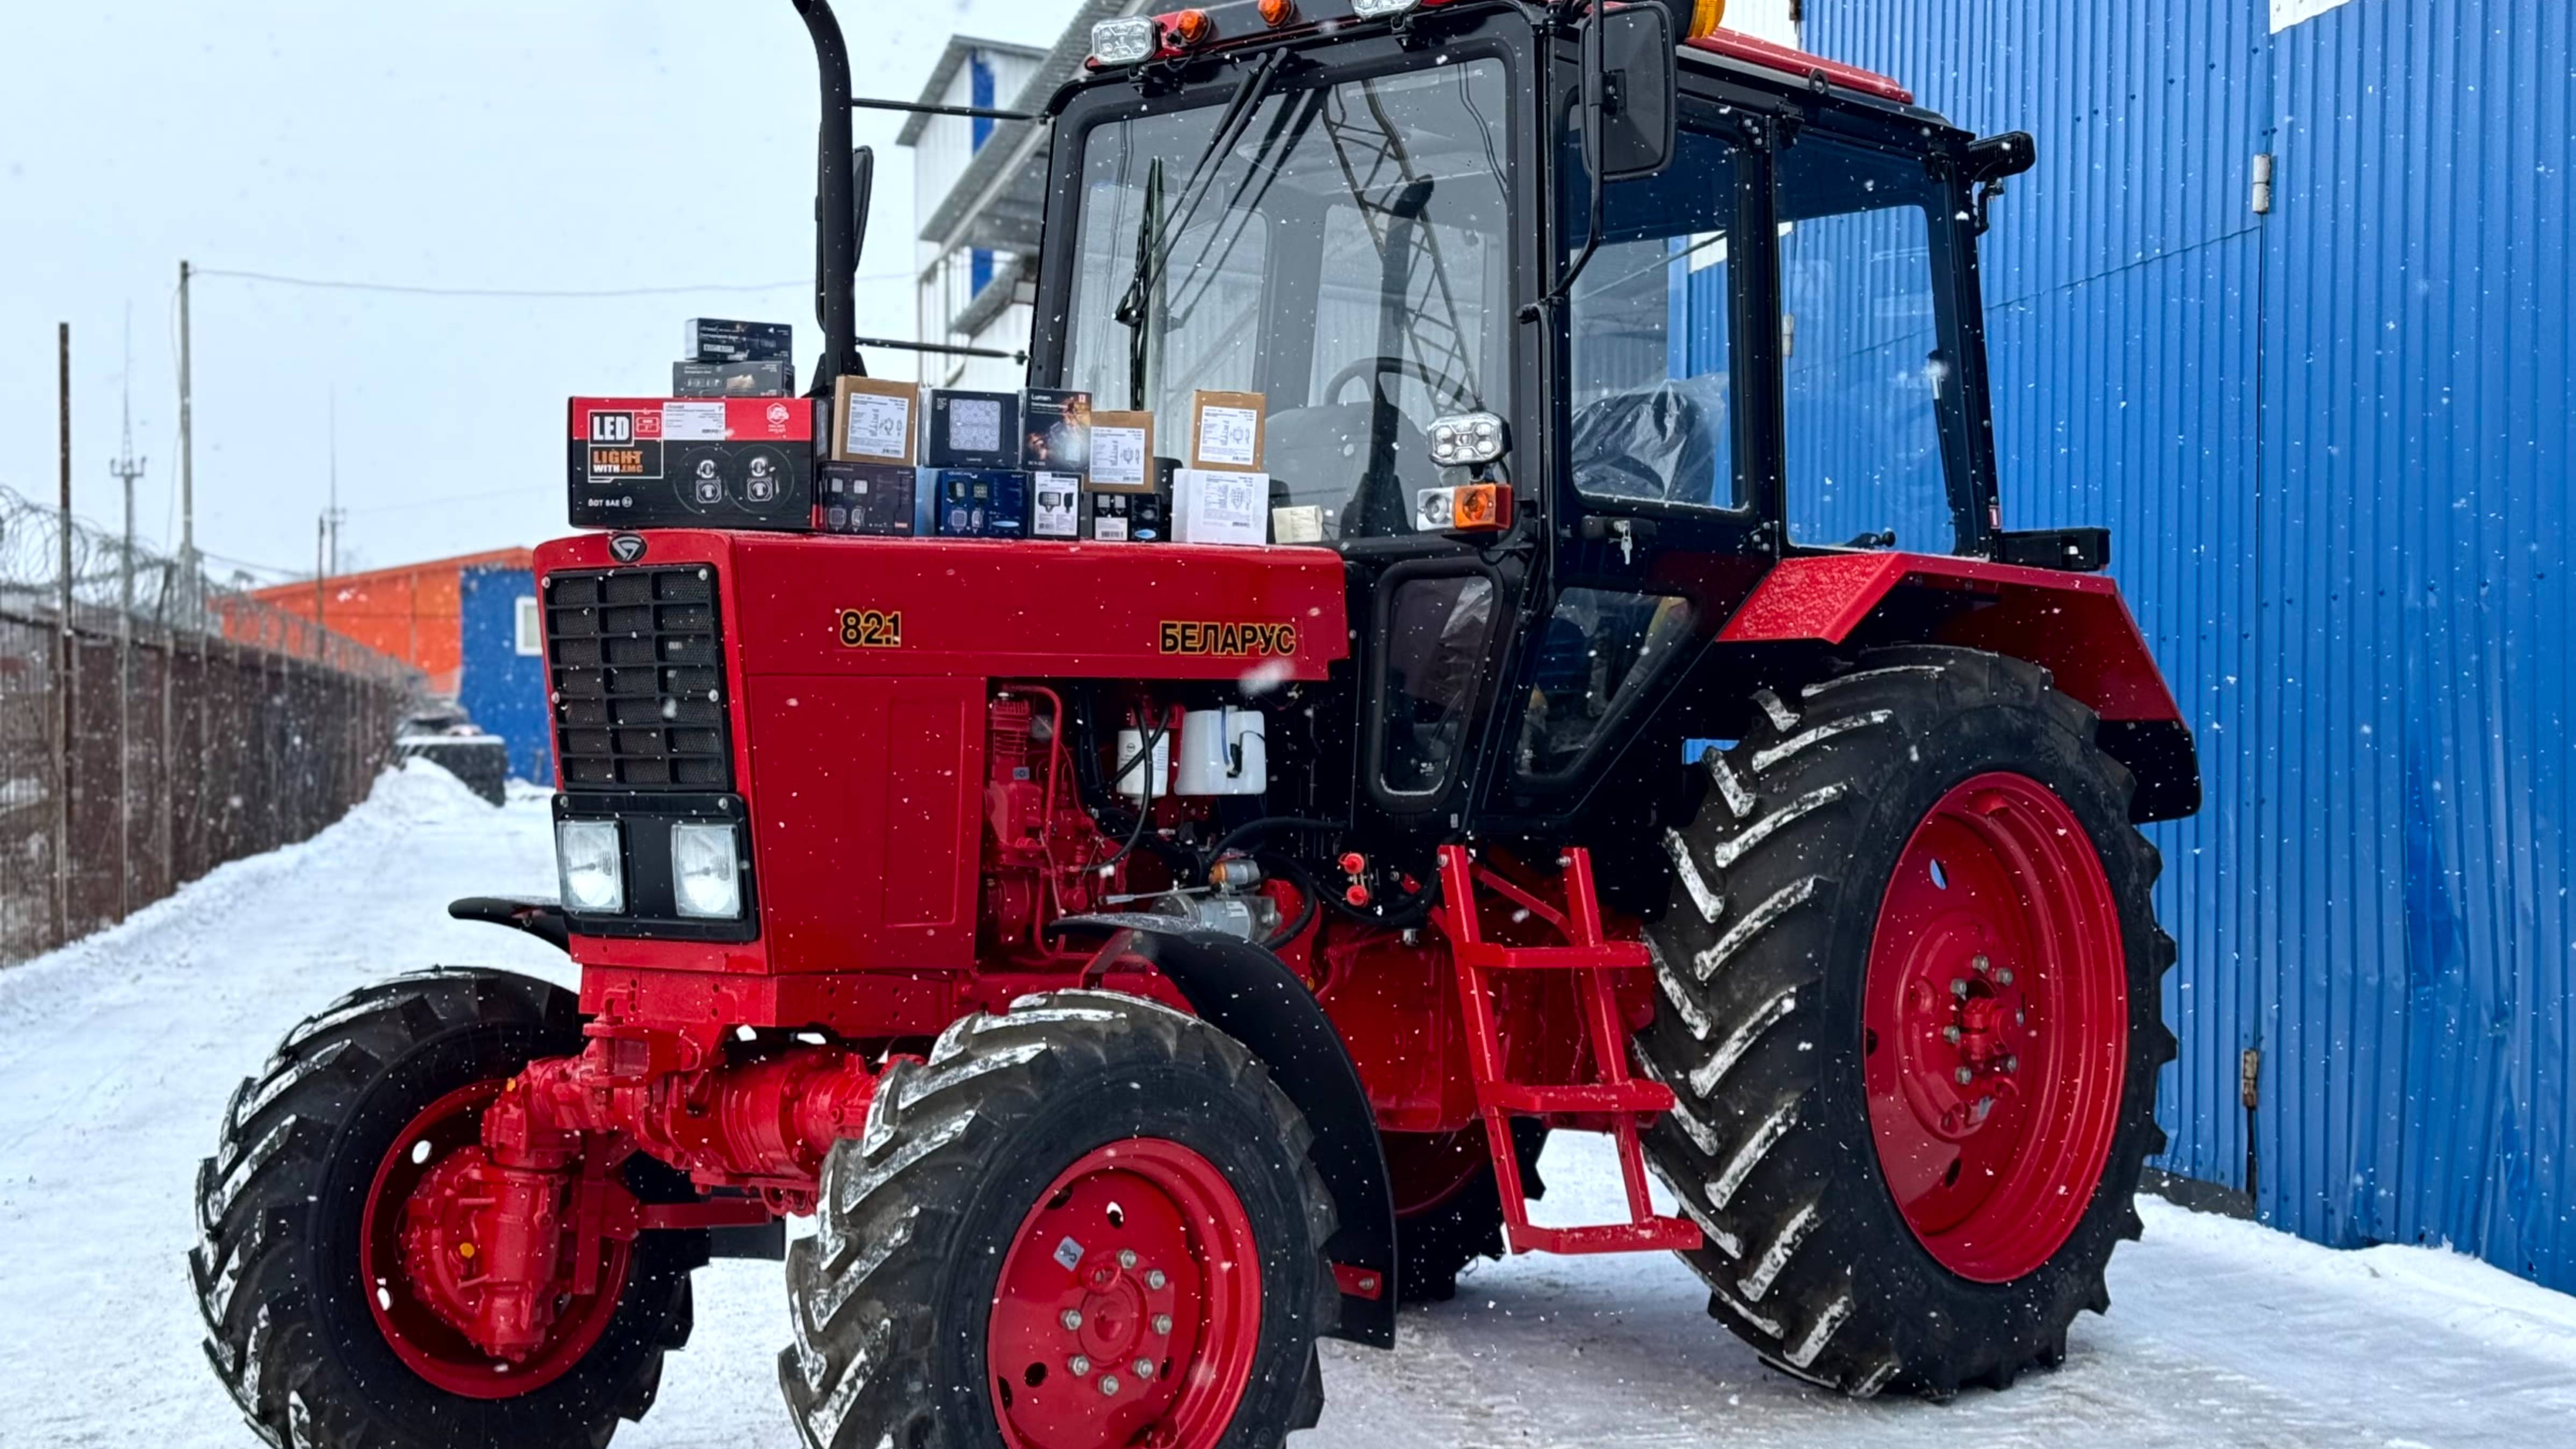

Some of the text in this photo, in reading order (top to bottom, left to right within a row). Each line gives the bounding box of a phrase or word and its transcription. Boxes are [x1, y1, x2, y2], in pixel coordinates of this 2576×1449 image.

[593, 416, 629, 441] LED
[593, 450, 643, 464] LIGHT
[593, 464, 620, 473] WITH
[840, 609, 901, 647] 82.1
[1159, 621, 1297, 655] БЕЛАРУС
